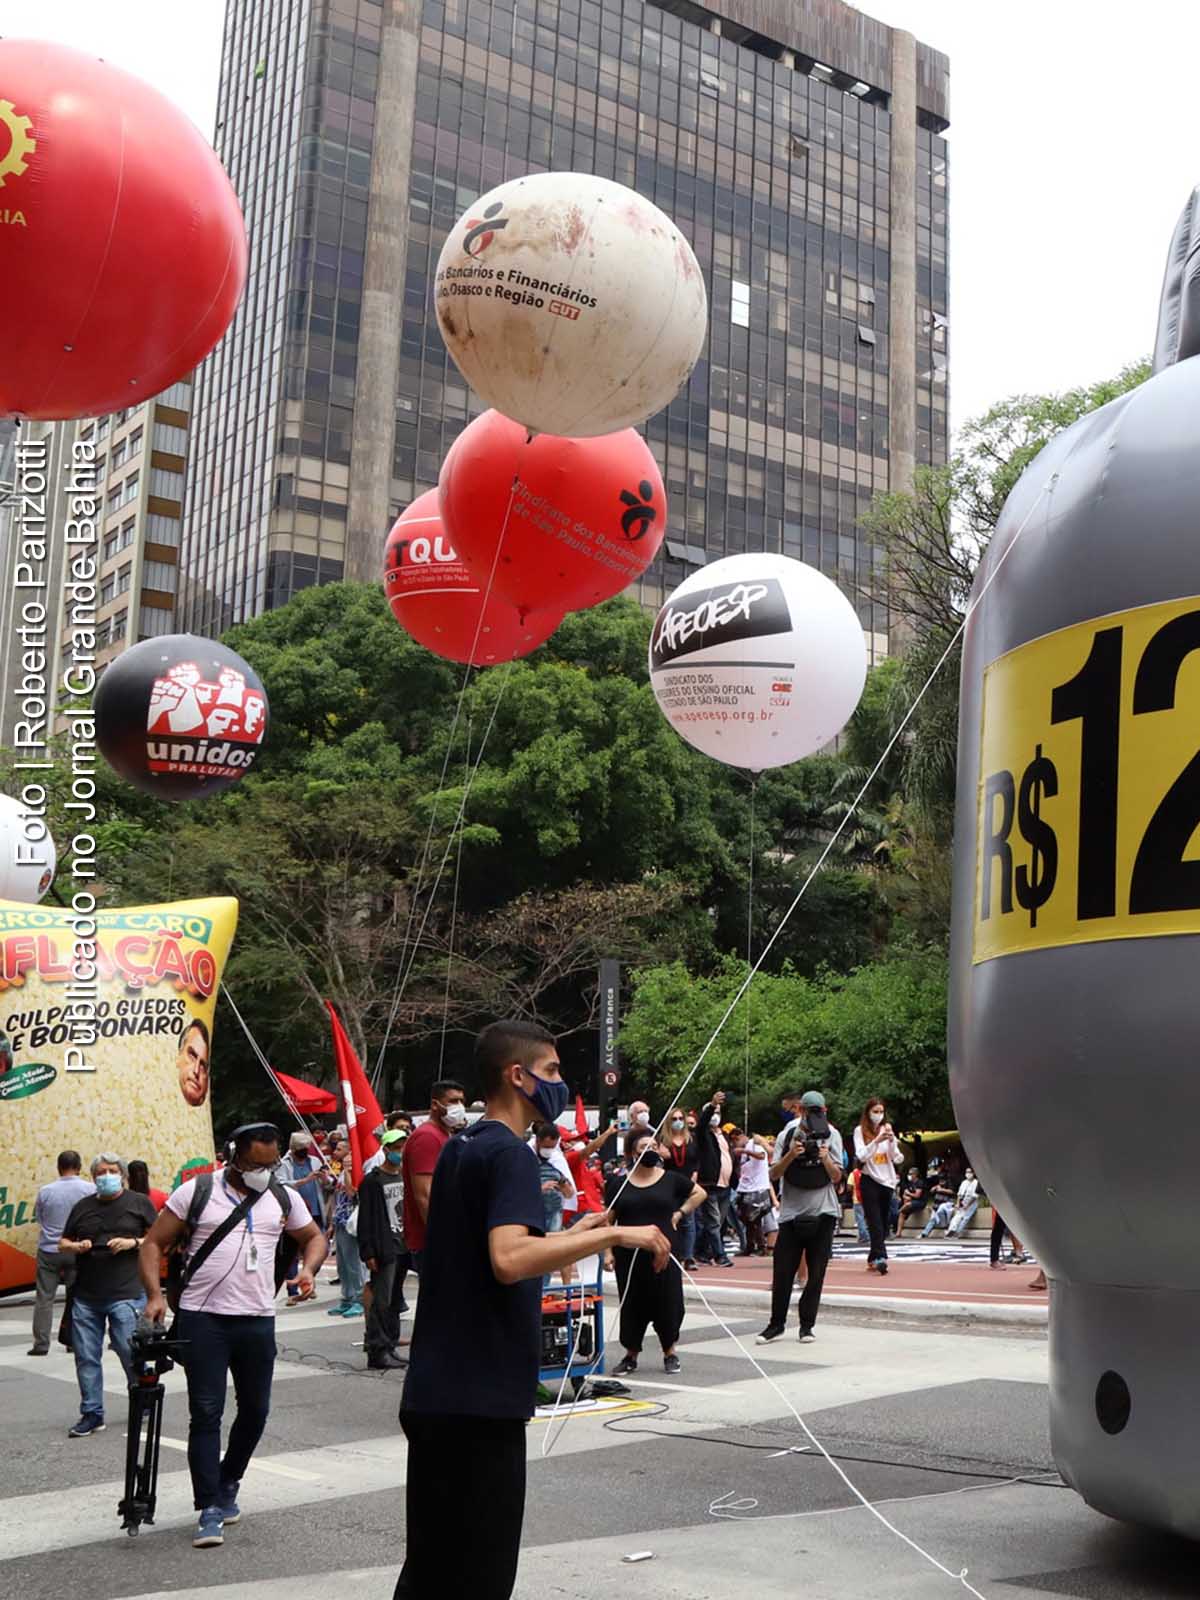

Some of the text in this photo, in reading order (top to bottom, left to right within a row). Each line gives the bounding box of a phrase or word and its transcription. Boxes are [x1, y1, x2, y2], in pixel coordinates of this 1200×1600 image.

[0, 208, 28, 227] IA
[446, 264, 494, 280] Bancários
[496, 270, 505, 281] e
[507, 269, 598, 309] Financiários
[450, 282, 483, 296] Osasco
[485, 286, 493, 297] e
[495, 284, 545, 309] Região
[549, 300, 581, 320] CUT
[654, 585, 768, 654] APEOESP
[698, 673, 714, 685] DOS
[693, 685, 720, 696] ENSINO
[721, 684, 756, 696] OFICIAL
[713, 695, 739, 706] PAULO
[146, 740, 256, 768] unidos
[167, 763, 238, 778] PRA LUTAR
[978, 742, 1060, 929] R$
[125, 913, 207, 939] CARO
[116, 998, 186, 1017] GUEDES
[605, 987, 614, 1025] Branca
[12, 1033, 25, 1052] E
